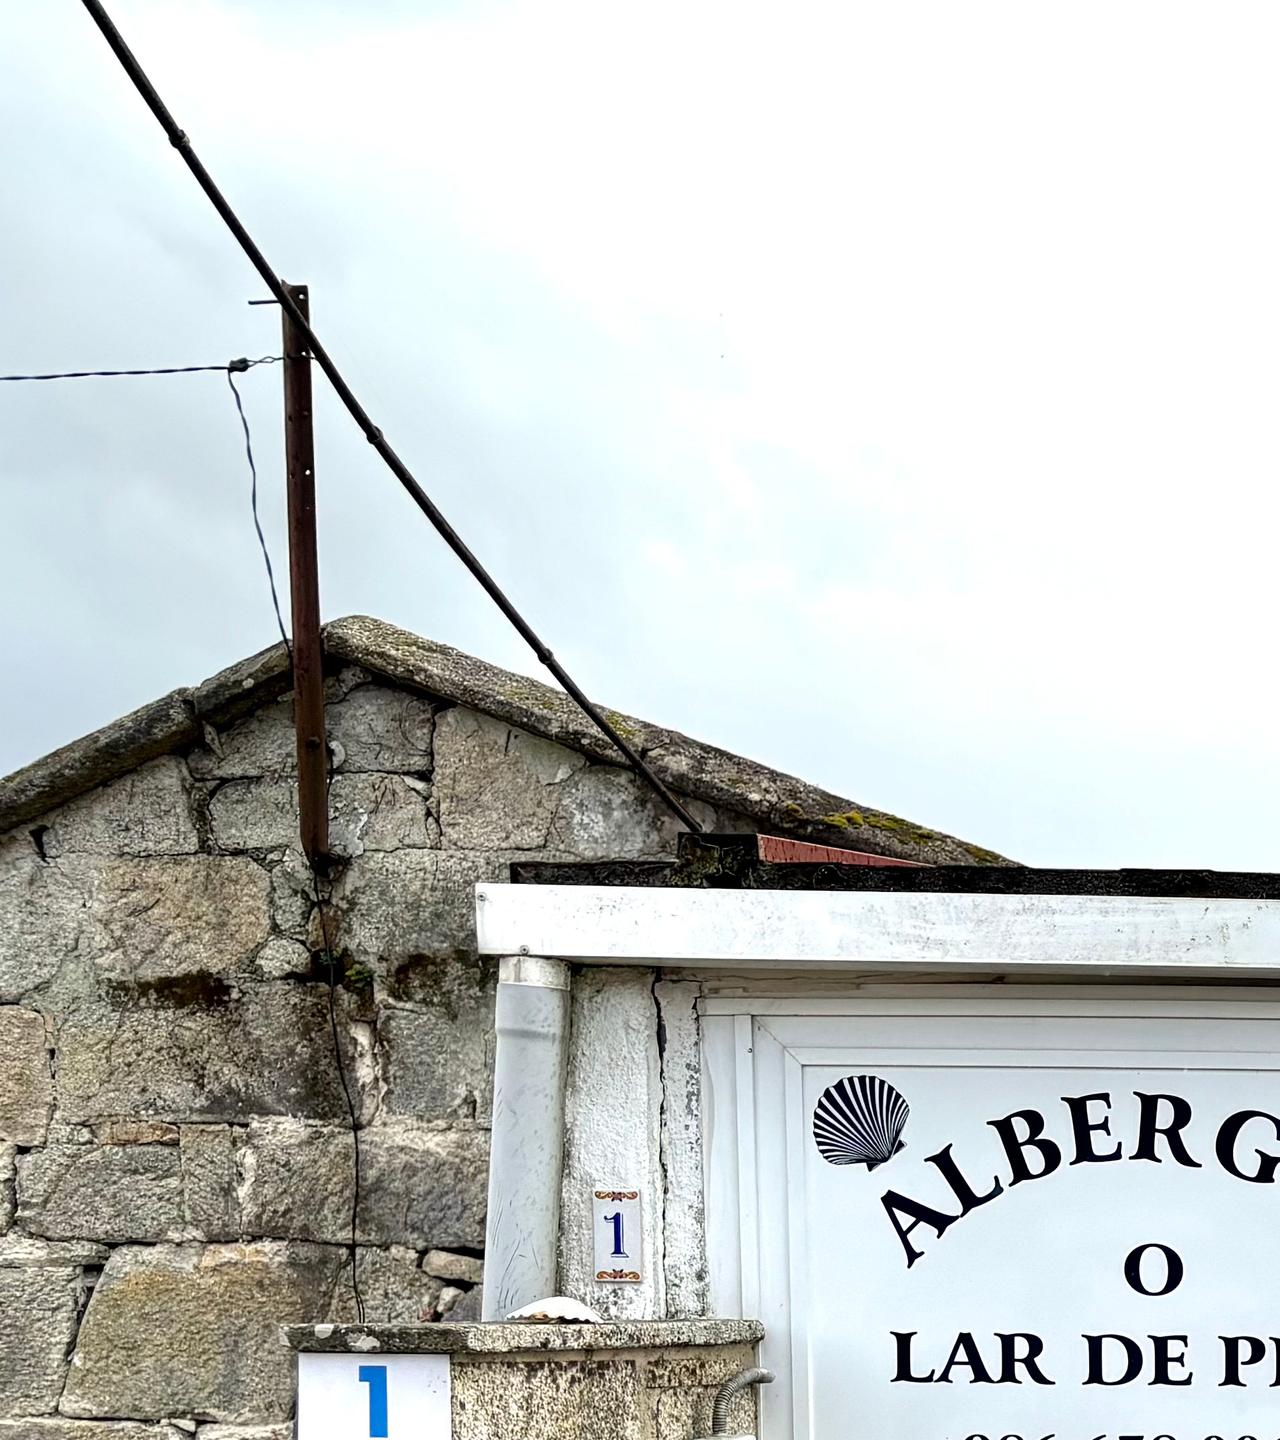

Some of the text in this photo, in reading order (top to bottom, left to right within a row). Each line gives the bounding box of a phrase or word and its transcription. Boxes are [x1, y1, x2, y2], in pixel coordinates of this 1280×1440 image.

[604, 1212, 629, 1258] 1
[1124, 1244, 1183, 1296] O
[890, 1331, 1055, 1385] LAR
[1081, 1334, 1193, 1385] DE
[359, 1365, 388, 1438] 1
